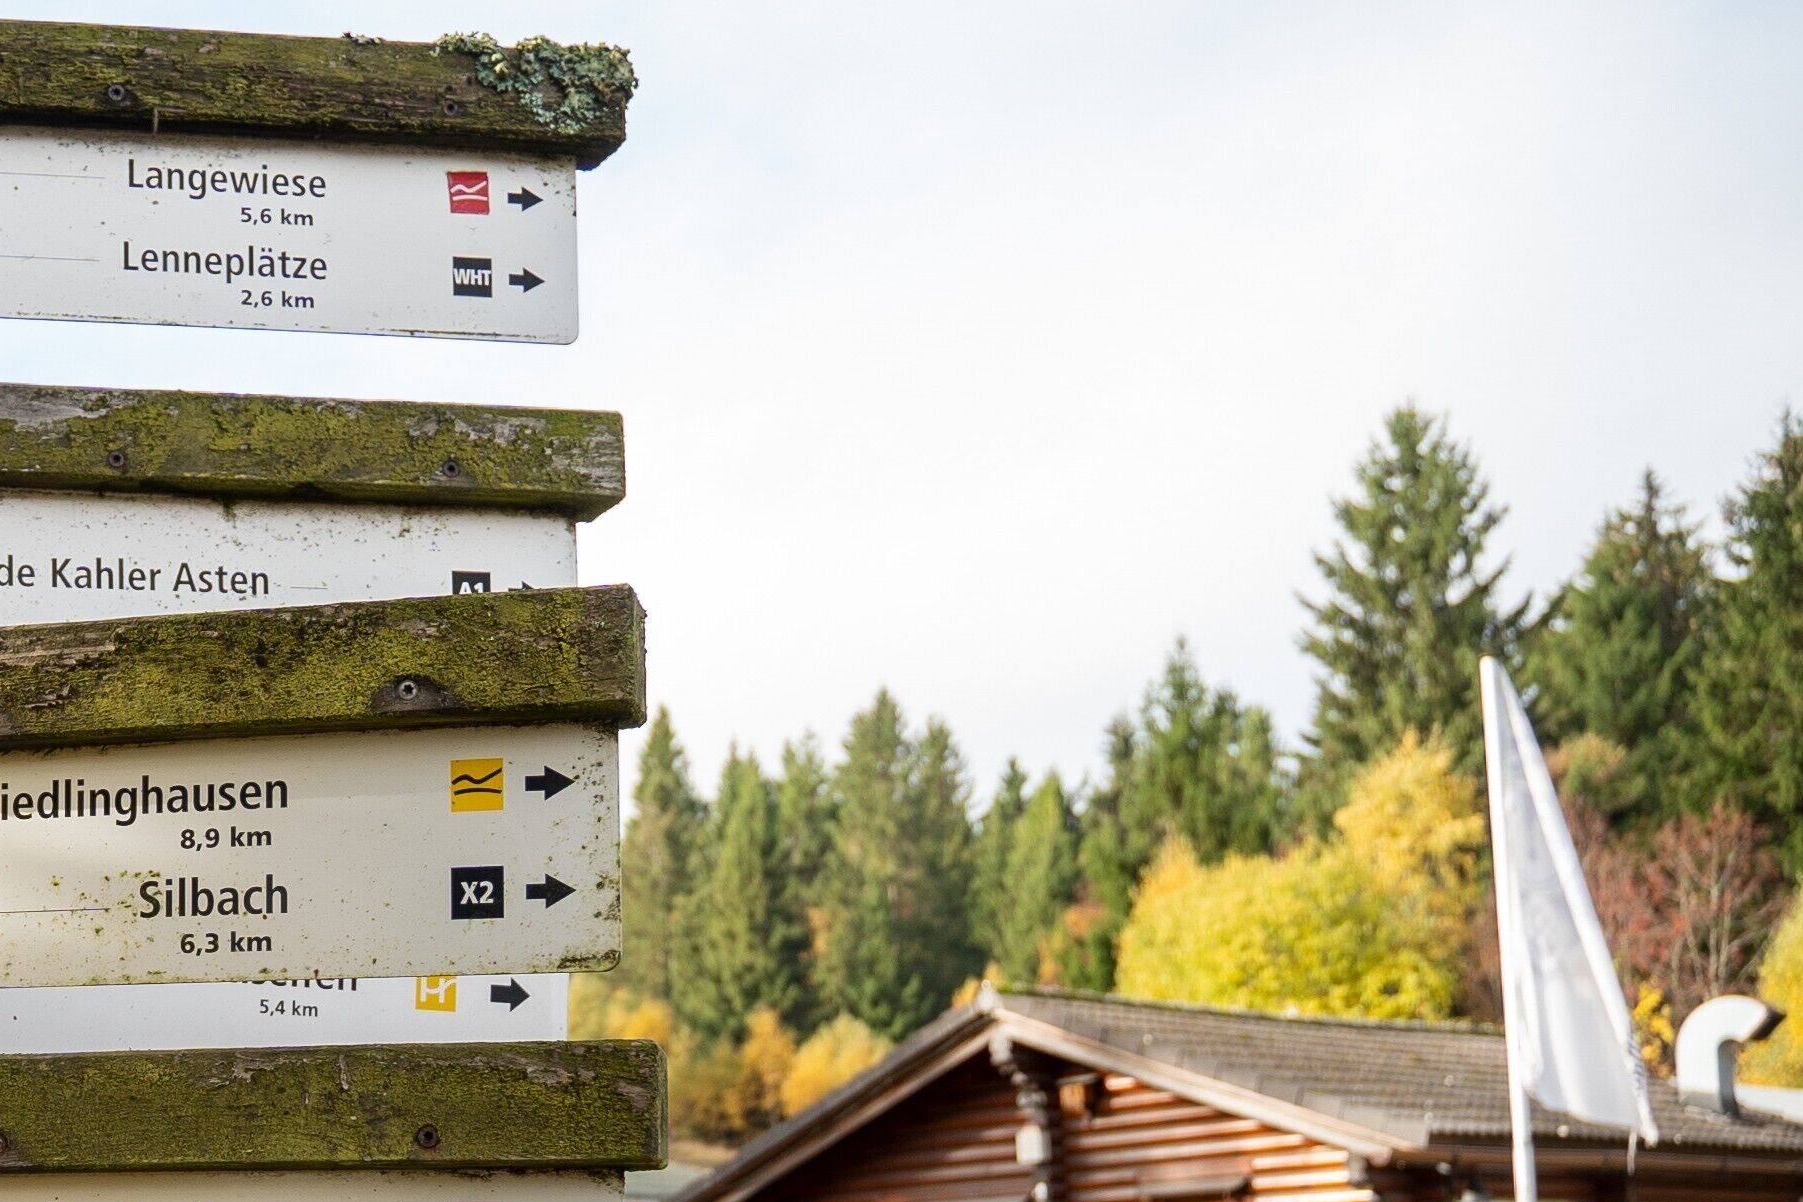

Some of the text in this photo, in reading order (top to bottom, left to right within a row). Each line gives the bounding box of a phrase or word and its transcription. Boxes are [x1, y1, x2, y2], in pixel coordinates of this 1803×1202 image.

[128, 158, 327, 200] Langewiese
[240, 207, 314, 226] 5,6 km
[123, 241, 328, 284] Lenneplätze
[453, 268, 493, 286] WHT
[241, 289, 315, 309] 2,6 km
[51, 557, 162, 591] Kahler
[172, 562, 269, 596] Asten
[180, 825, 272, 852] 8,9 km
[139, 875, 288, 920] Silbach
[459, 880, 495, 905] X2
[180, 930, 272, 957] 6,3 km
[259, 998, 318, 1018] 5,4 km
